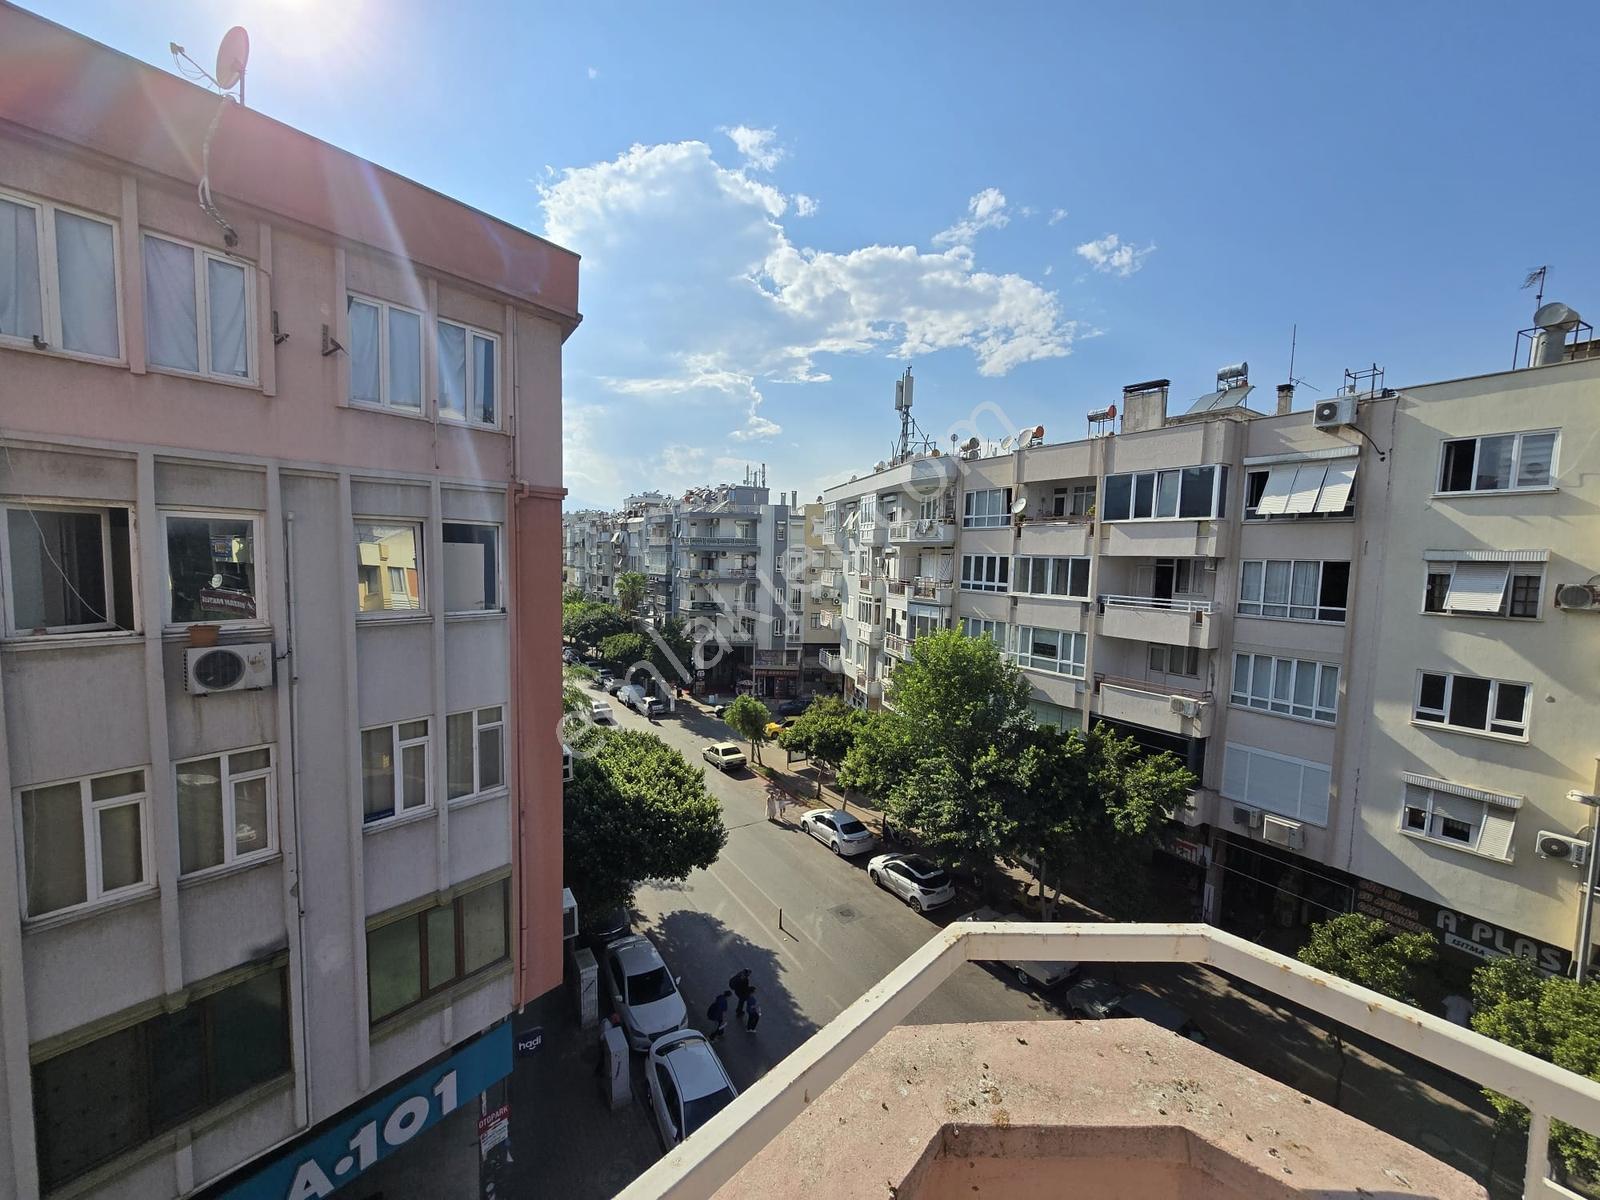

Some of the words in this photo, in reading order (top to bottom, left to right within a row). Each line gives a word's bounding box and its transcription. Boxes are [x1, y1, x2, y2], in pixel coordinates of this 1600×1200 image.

[1472, 922, 1560, 971] PLAS
[518, 1034, 542, 1051] hadi
[478, 1105, 508, 1129] OTOPARK
